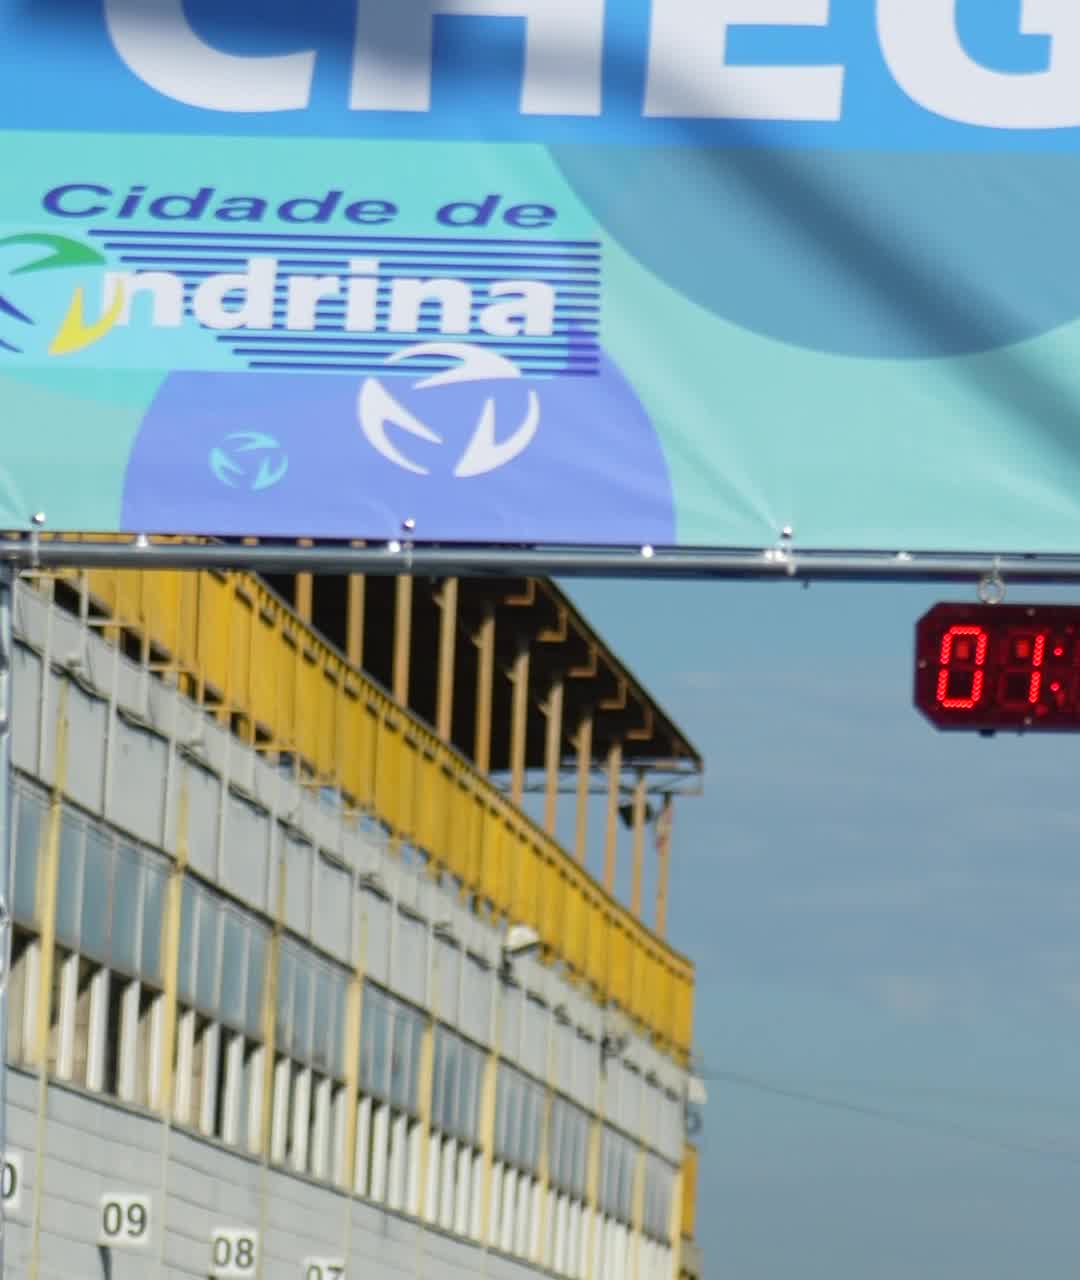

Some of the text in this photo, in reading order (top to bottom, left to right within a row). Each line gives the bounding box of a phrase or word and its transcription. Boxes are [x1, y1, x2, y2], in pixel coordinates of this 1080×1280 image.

[41, 183, 558, 229] Cidade de
[102, 1202, 148, 1237] 09
[212, 1236, 255, 1269] 08
